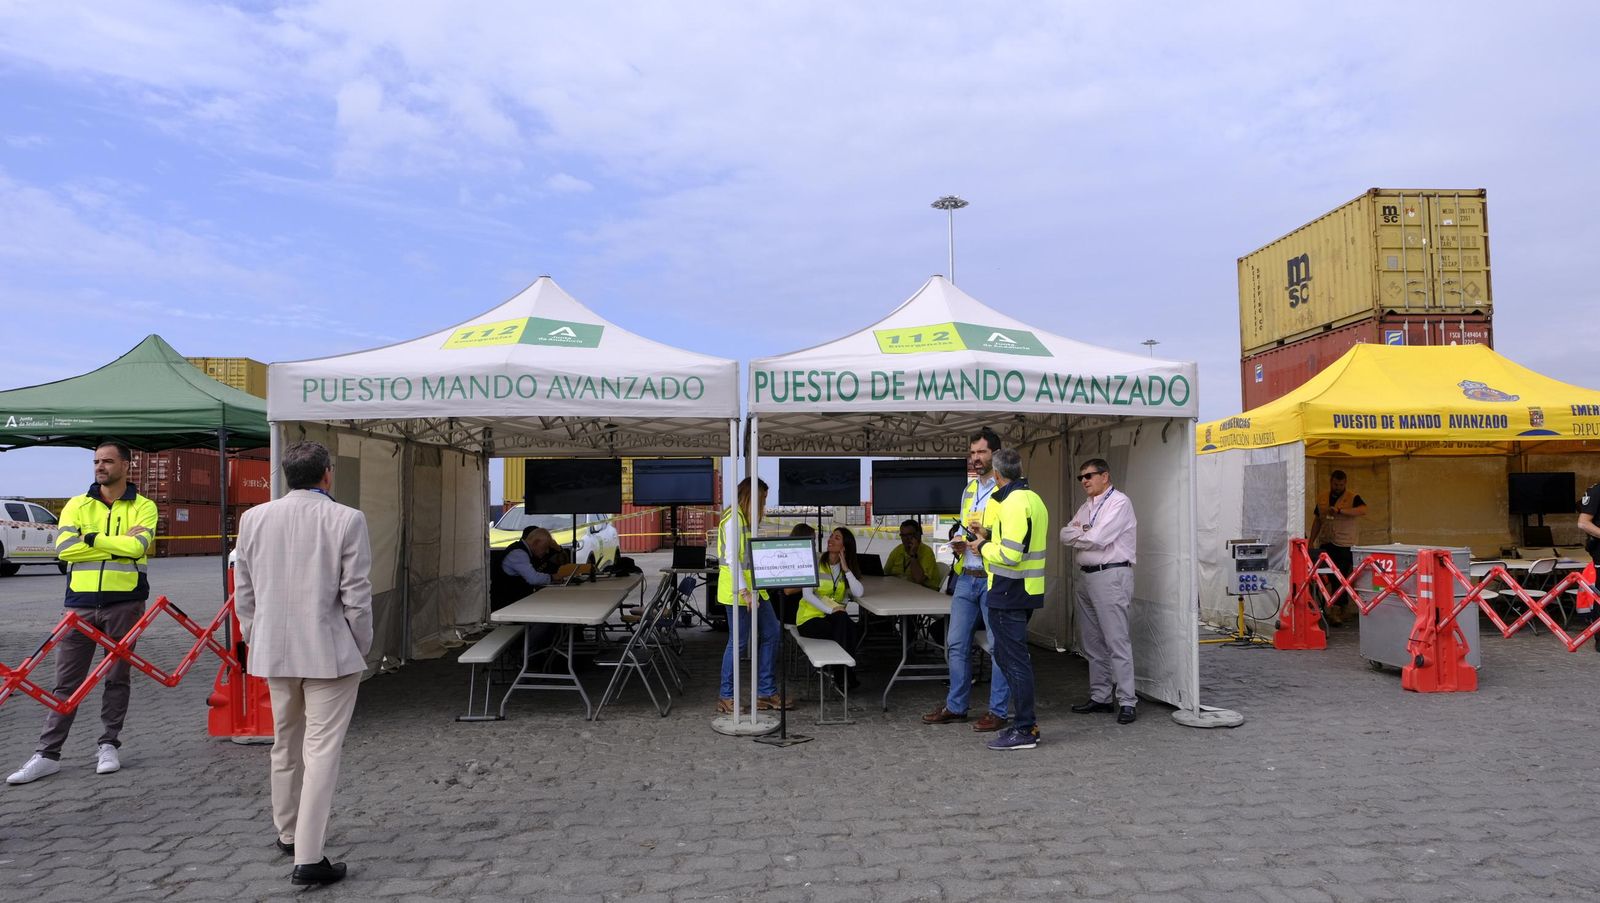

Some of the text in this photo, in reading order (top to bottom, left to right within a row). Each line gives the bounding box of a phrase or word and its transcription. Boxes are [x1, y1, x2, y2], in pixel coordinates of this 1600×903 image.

[460, 325, 519, 340] 112
[886, 331, 950, 344] 112
[302, 374, 705, 403] PUESTO MANDO AVANZADO
[754, 369, 1190, 406] PUESTO DE MANDO AVANZADO
[1333, 414, 1508, 429] PUESTO DE MANDO AVANZADO
